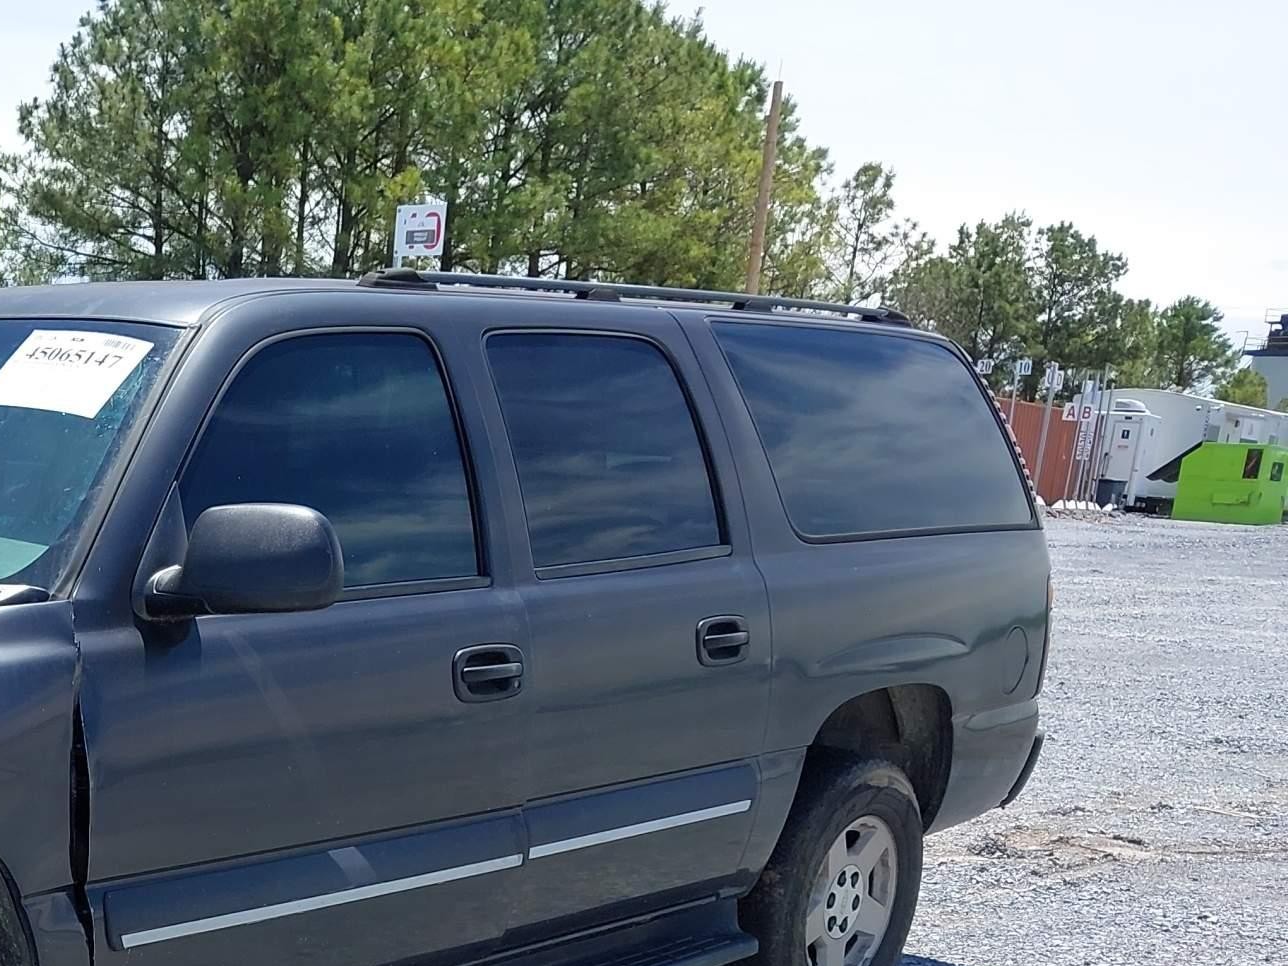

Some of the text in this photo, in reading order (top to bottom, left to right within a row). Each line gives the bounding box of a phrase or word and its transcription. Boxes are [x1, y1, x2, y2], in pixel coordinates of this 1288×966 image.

[25, 346, 123, 367] 45065147
[980, 361, 992, 372] 20
[1019, 362, 1030, 373] 10
[1066, 406, 1076, 418] A
[1082, 406, 1092, 419] B
